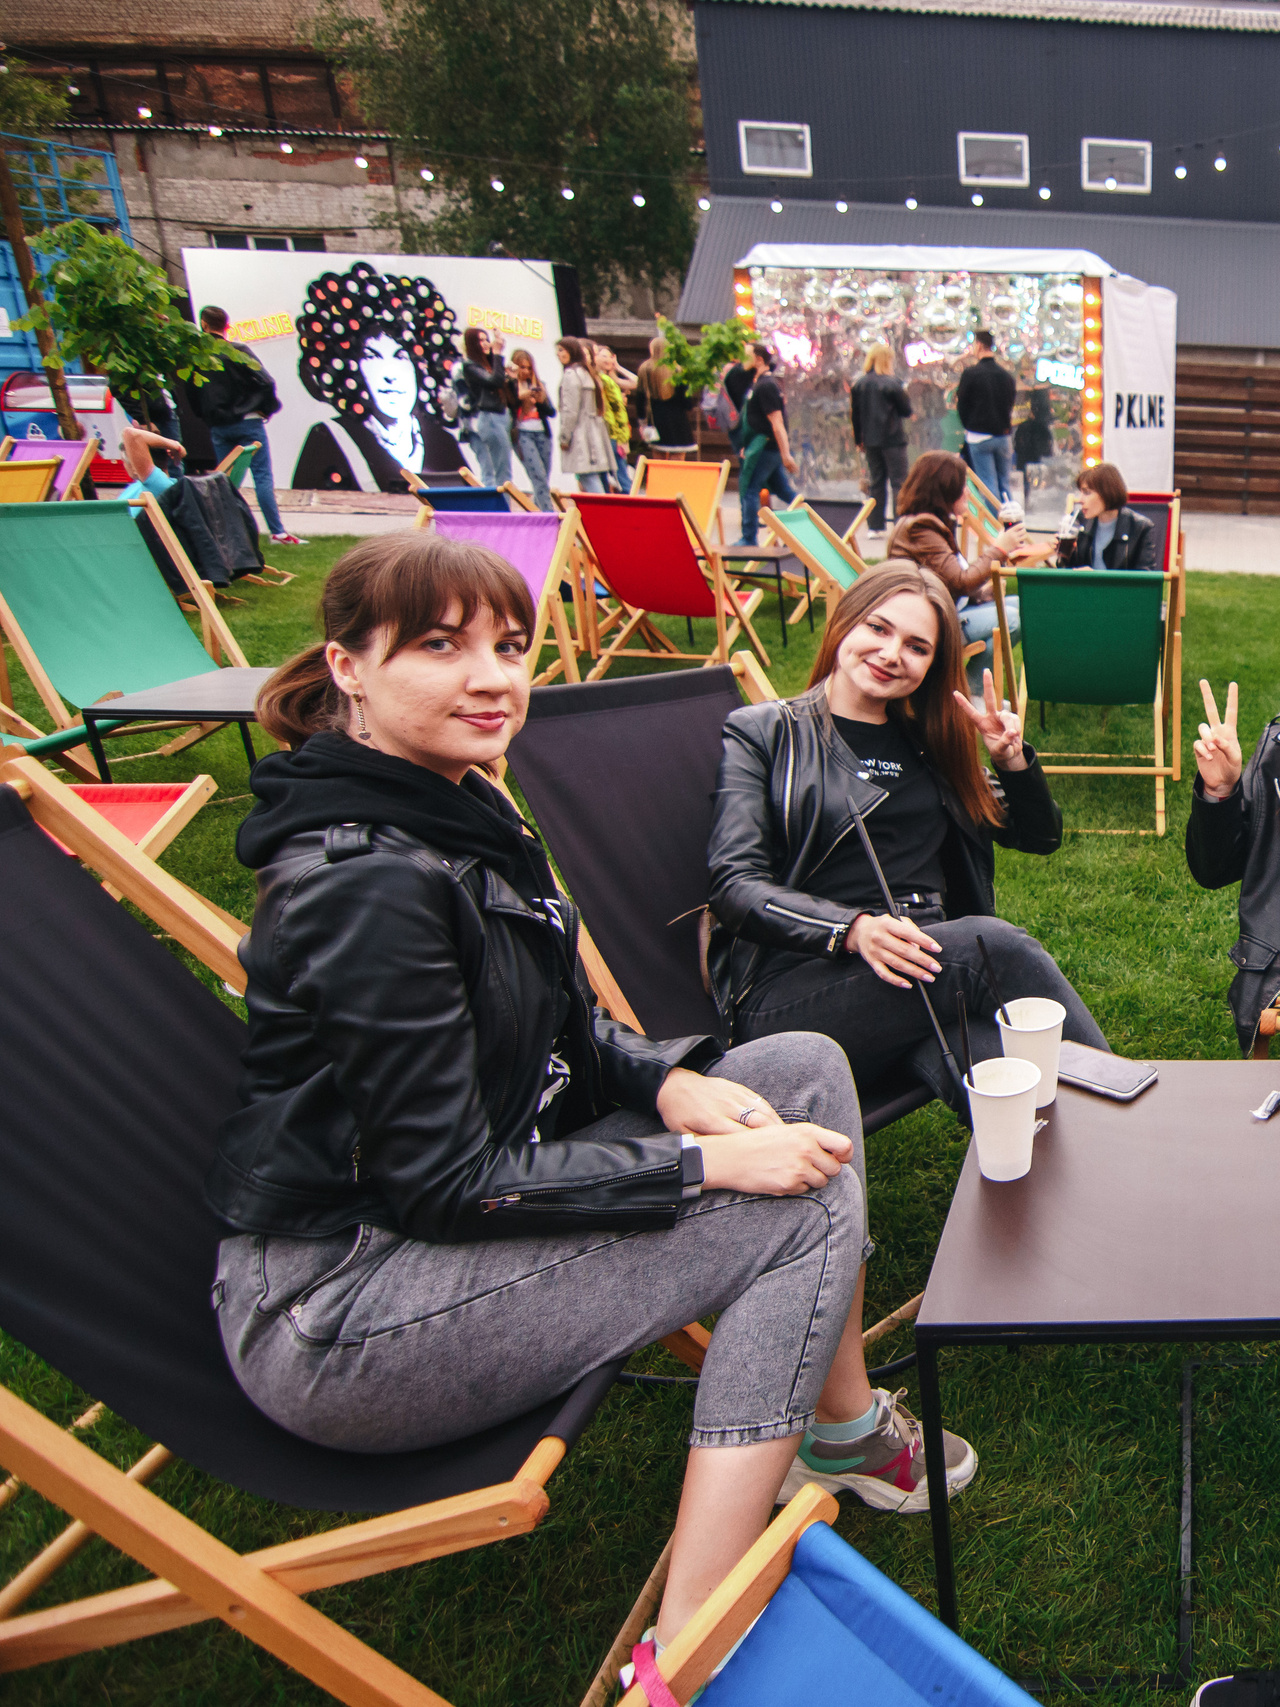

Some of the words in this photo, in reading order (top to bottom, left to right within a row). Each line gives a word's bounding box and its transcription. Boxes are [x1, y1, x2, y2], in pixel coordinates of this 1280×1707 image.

[468, 306, 543, 340] PKLNE
[1115, 391, 1164, 428] PKLNE
[877, 760, 904, 771] YORK
